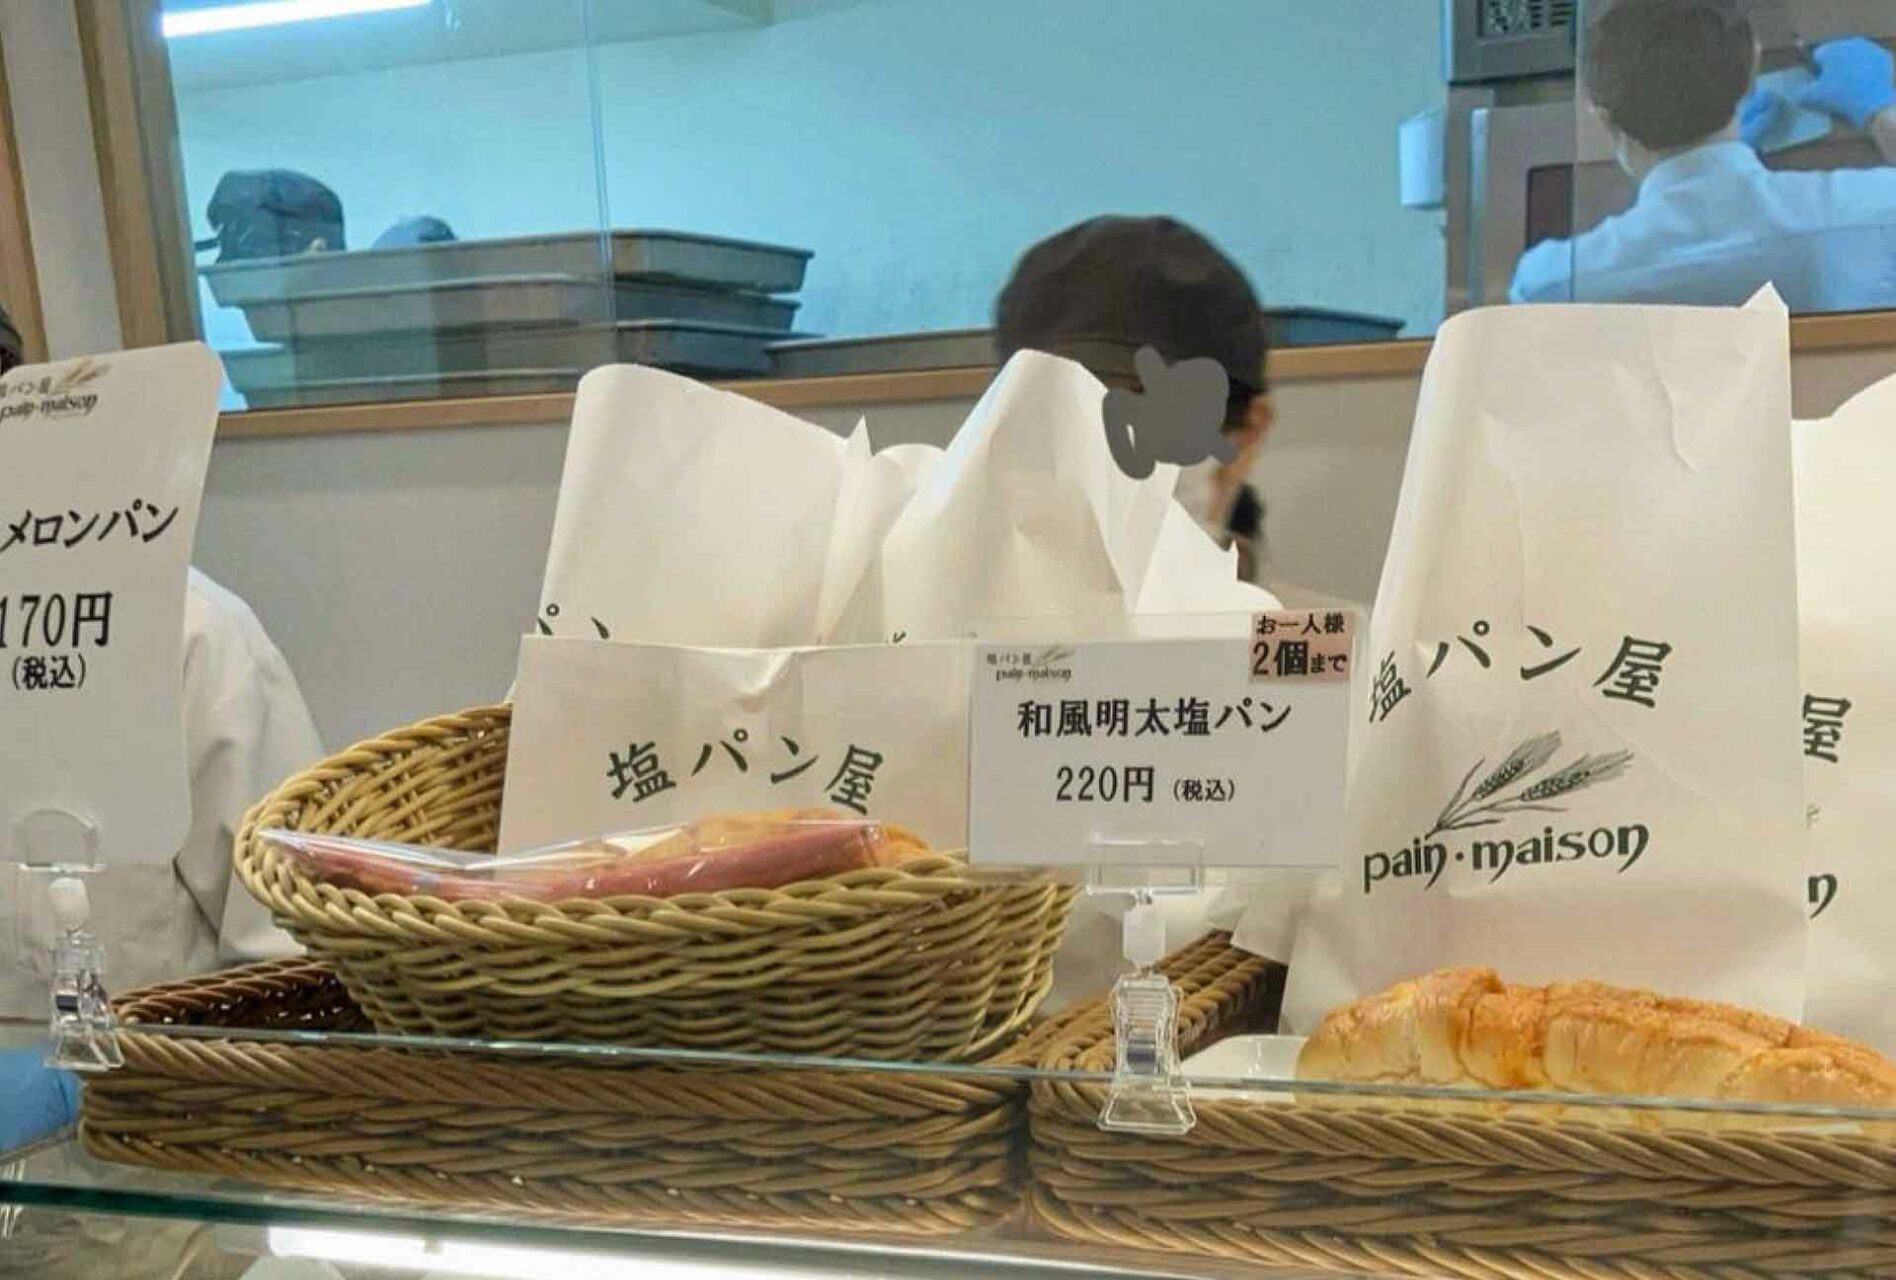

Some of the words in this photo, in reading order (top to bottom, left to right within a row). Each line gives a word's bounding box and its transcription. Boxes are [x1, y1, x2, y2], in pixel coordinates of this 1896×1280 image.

[0, 498, 179, 551] メロンパン
[0, 591, 113, 649] 170円
[1256, 611, 1345, 636] お一人様
[1253, 640, 1348, 677] 2個まで
[1367, 619, 1673, 723] 塩パン屋
[1017, 696, 1292, 738] 和風明太塩パン
[606, 728, 884, 816] 塩パン屋
[1056, 764, 1155, 803] 220円
